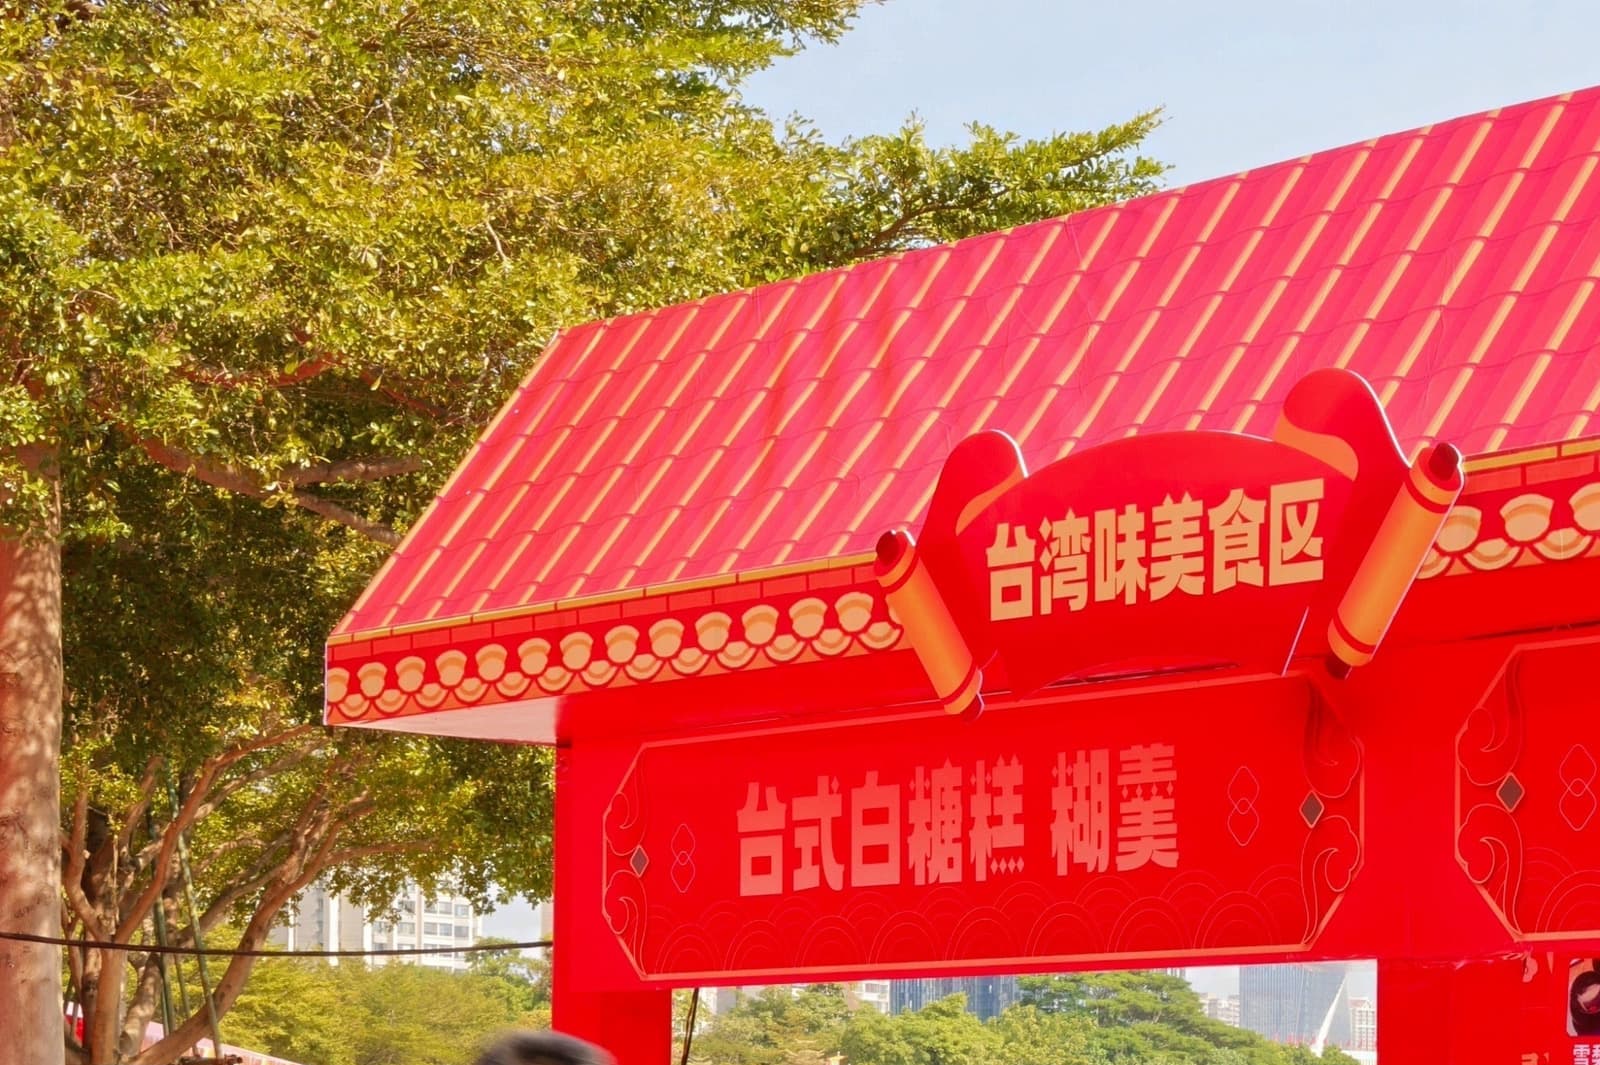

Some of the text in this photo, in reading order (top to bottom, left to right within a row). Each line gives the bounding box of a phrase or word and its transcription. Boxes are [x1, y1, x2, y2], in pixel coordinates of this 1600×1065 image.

[986, 478, 1324, 621] 台湾味美食区
[736, 756, 1025, 897] 台式白糖糕
